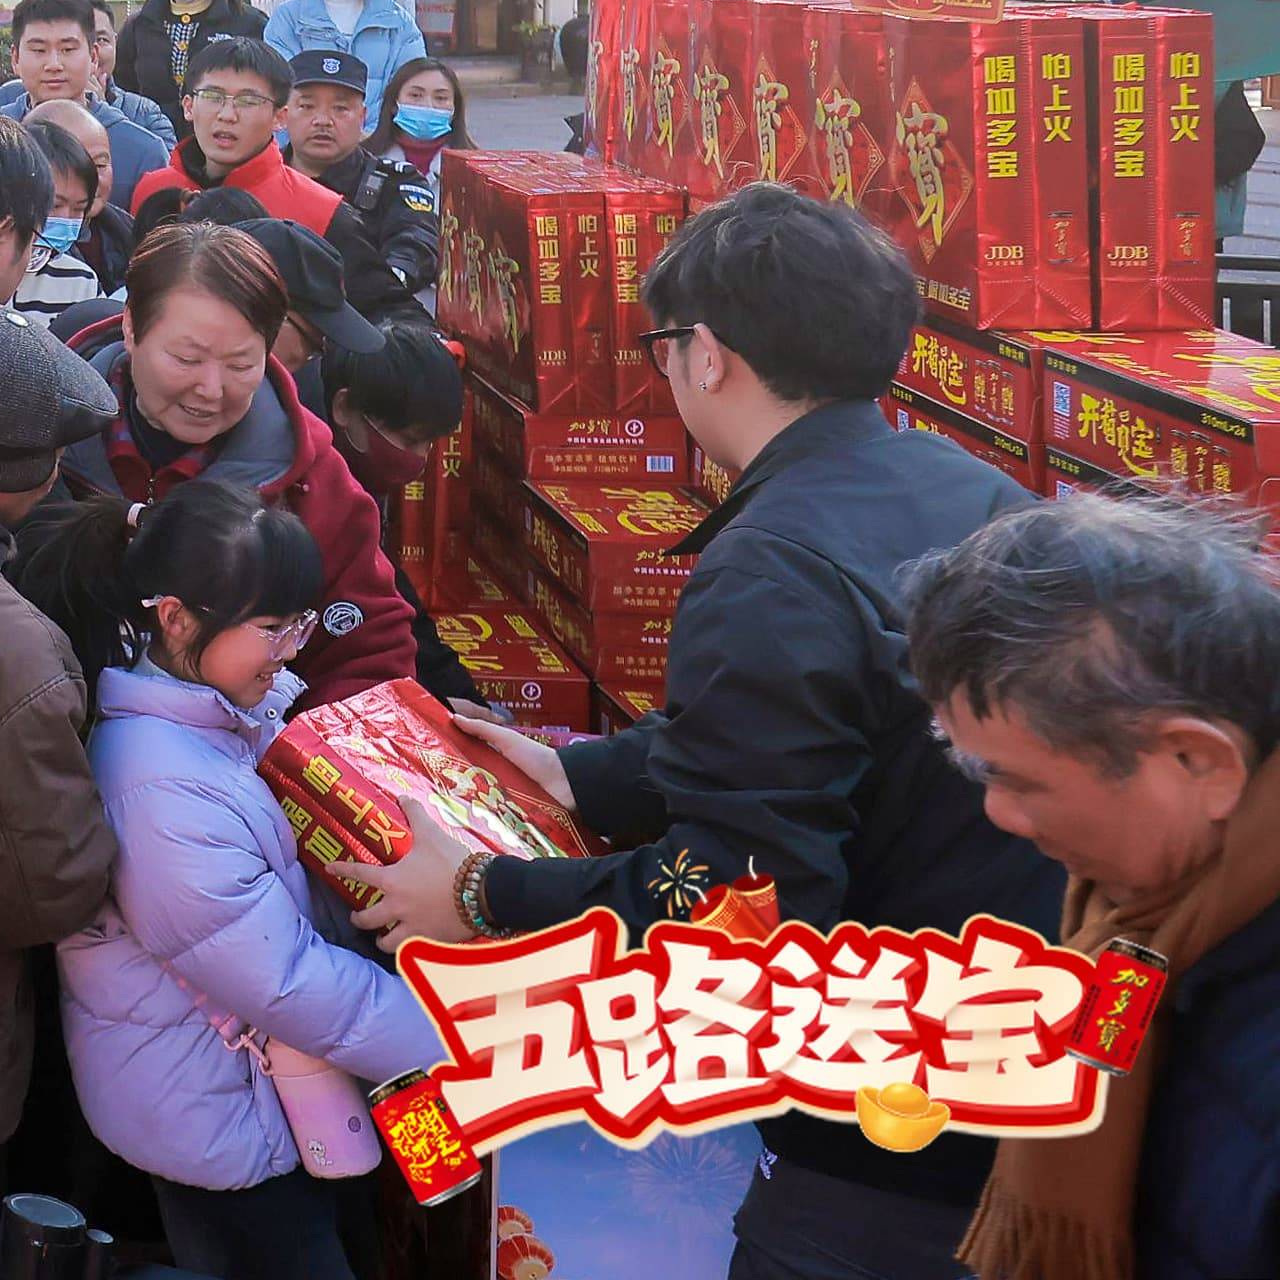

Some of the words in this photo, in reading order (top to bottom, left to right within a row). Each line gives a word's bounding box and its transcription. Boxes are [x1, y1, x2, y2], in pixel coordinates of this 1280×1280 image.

[984, 55, 1018, 178] 喝加多宝
[1042, 53, 1073, 143] 怕上火
[1113, 53, 1146, 178] 喝加多宝
[1170, 52, 1201, 142] 怕上火
[536, 216, 562, 304] 喝加多宝
[578, 215, 600, 278] 怕上火
[614, 214, 640, 303] 喝加多宝
[984, 246, 1024, 260] JDB
[1107, 246, 1149, 260] JDB
[912, 333, 967, 405] 开箱见宝
[1078, 393, 1158, 479] 开箱见宝
[302, 754, 407, 855] 怕上火
